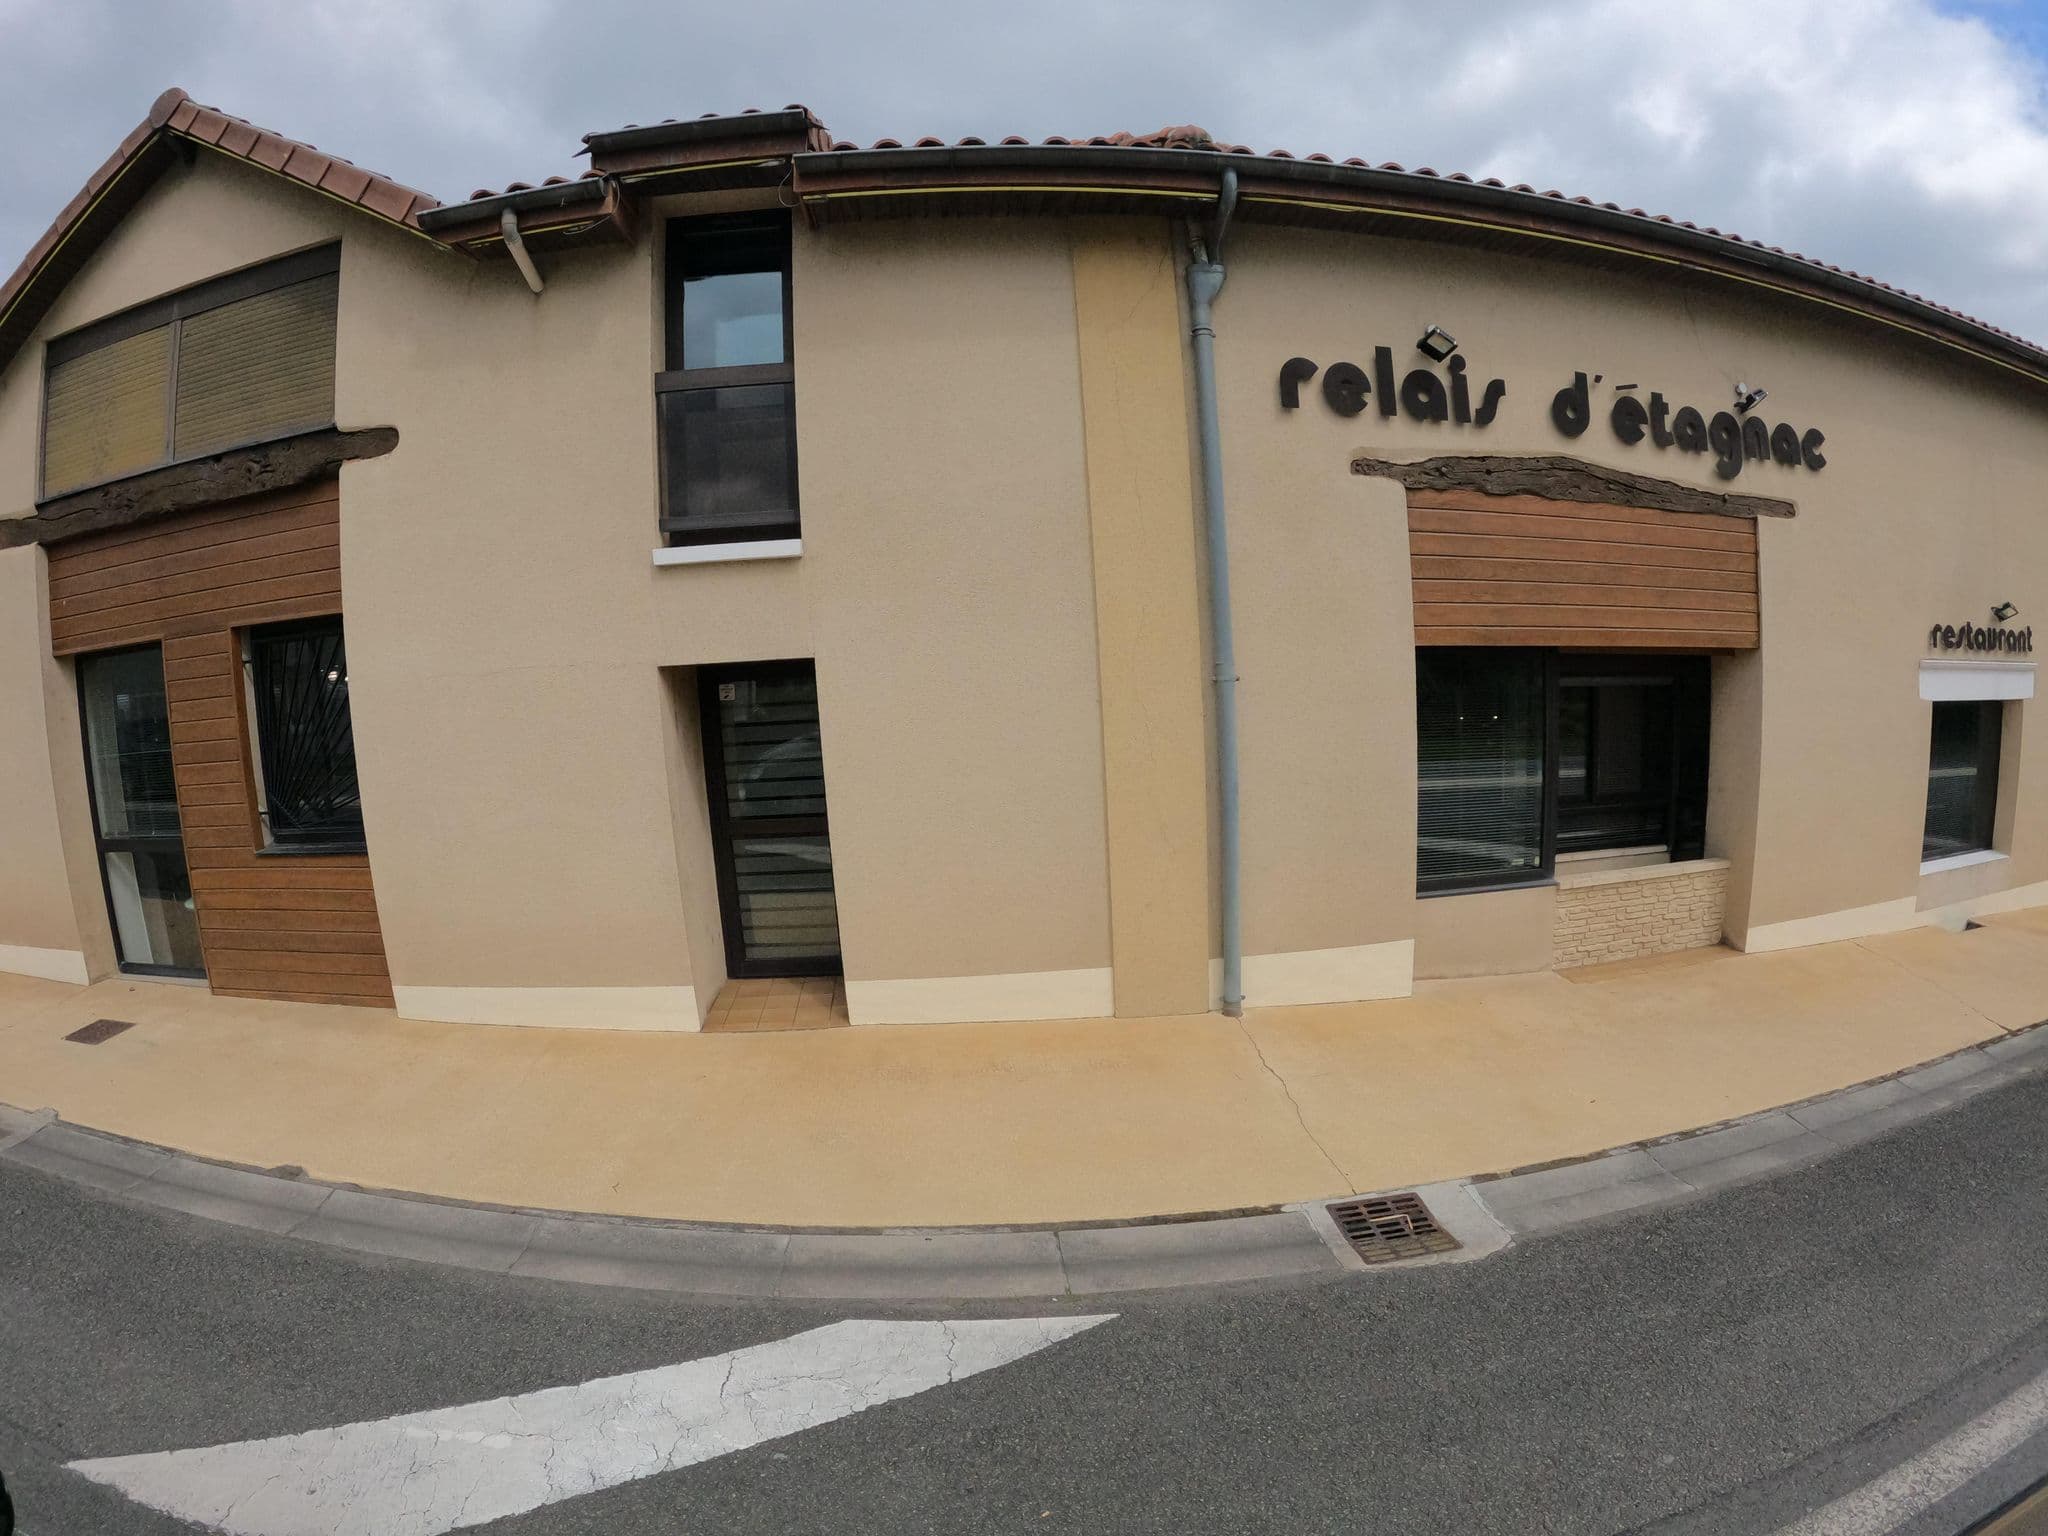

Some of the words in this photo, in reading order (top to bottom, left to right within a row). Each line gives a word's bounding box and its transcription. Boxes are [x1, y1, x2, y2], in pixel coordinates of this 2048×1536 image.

[1279, 345, 1507, 426] relais
[1552, 371, 1828, 480] d'étagnac
[1932, 621, 2033, 652] restaurant
